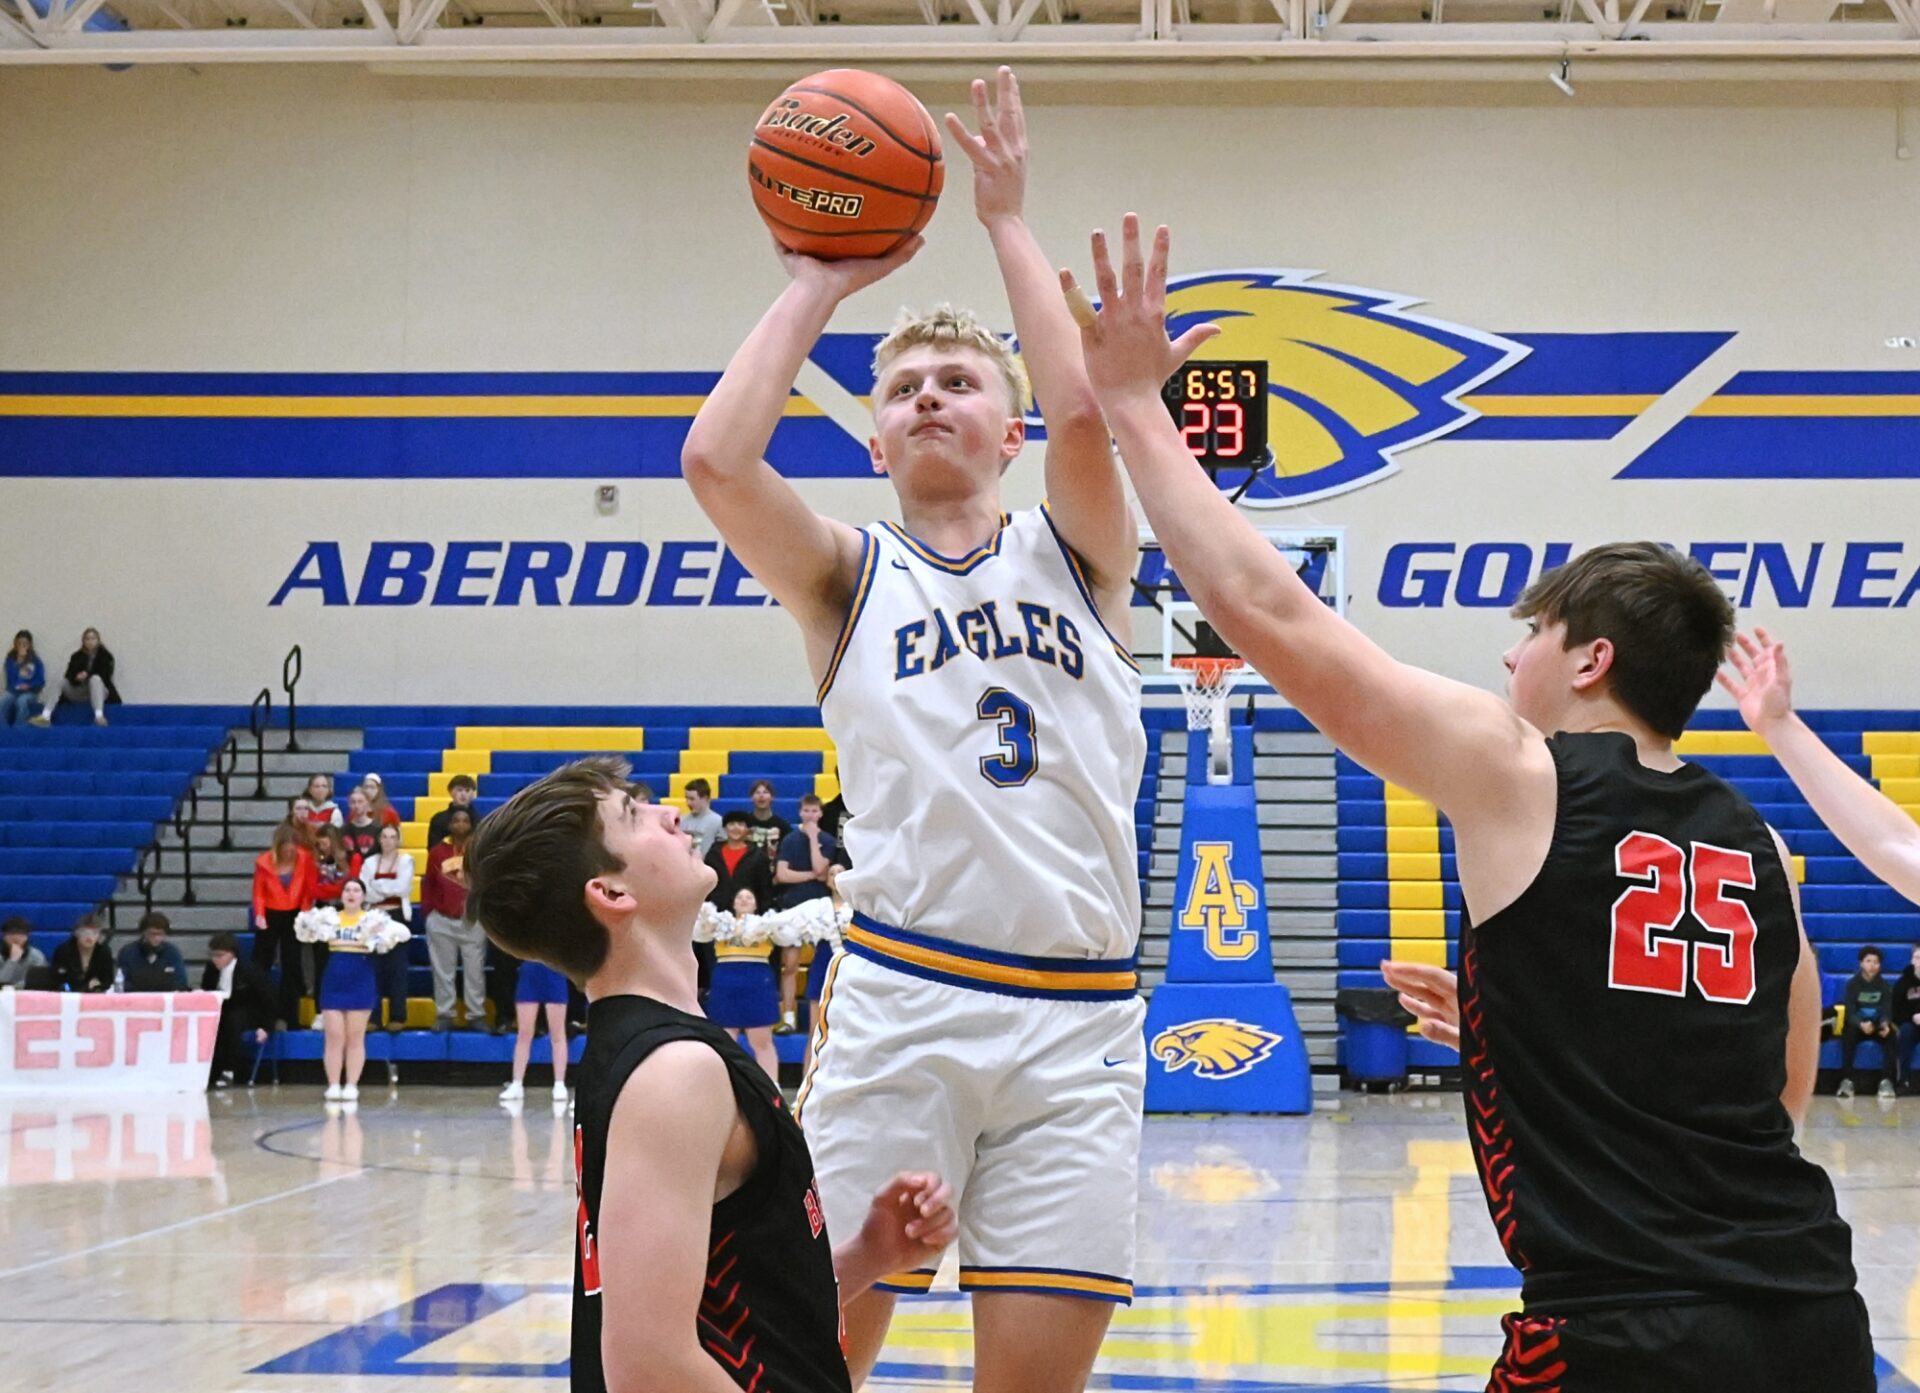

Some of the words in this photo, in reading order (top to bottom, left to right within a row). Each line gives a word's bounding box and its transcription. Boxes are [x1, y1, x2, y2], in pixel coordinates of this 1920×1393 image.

[764, 97, 877, 159] Baden
[813, 192, 861, 216] PRO
[1186, 370, 1256, 400] 6:57
[1180, 403, 1243, 456] 23
[267, 541, 782, 607] ABERDEE
[894, 600, 1084, 682] EAGLES
[976, 686, 1039, 788] 3
[1608, 830, 1758, 1006] 25
[14, 990, 220, 1070] ESPN
